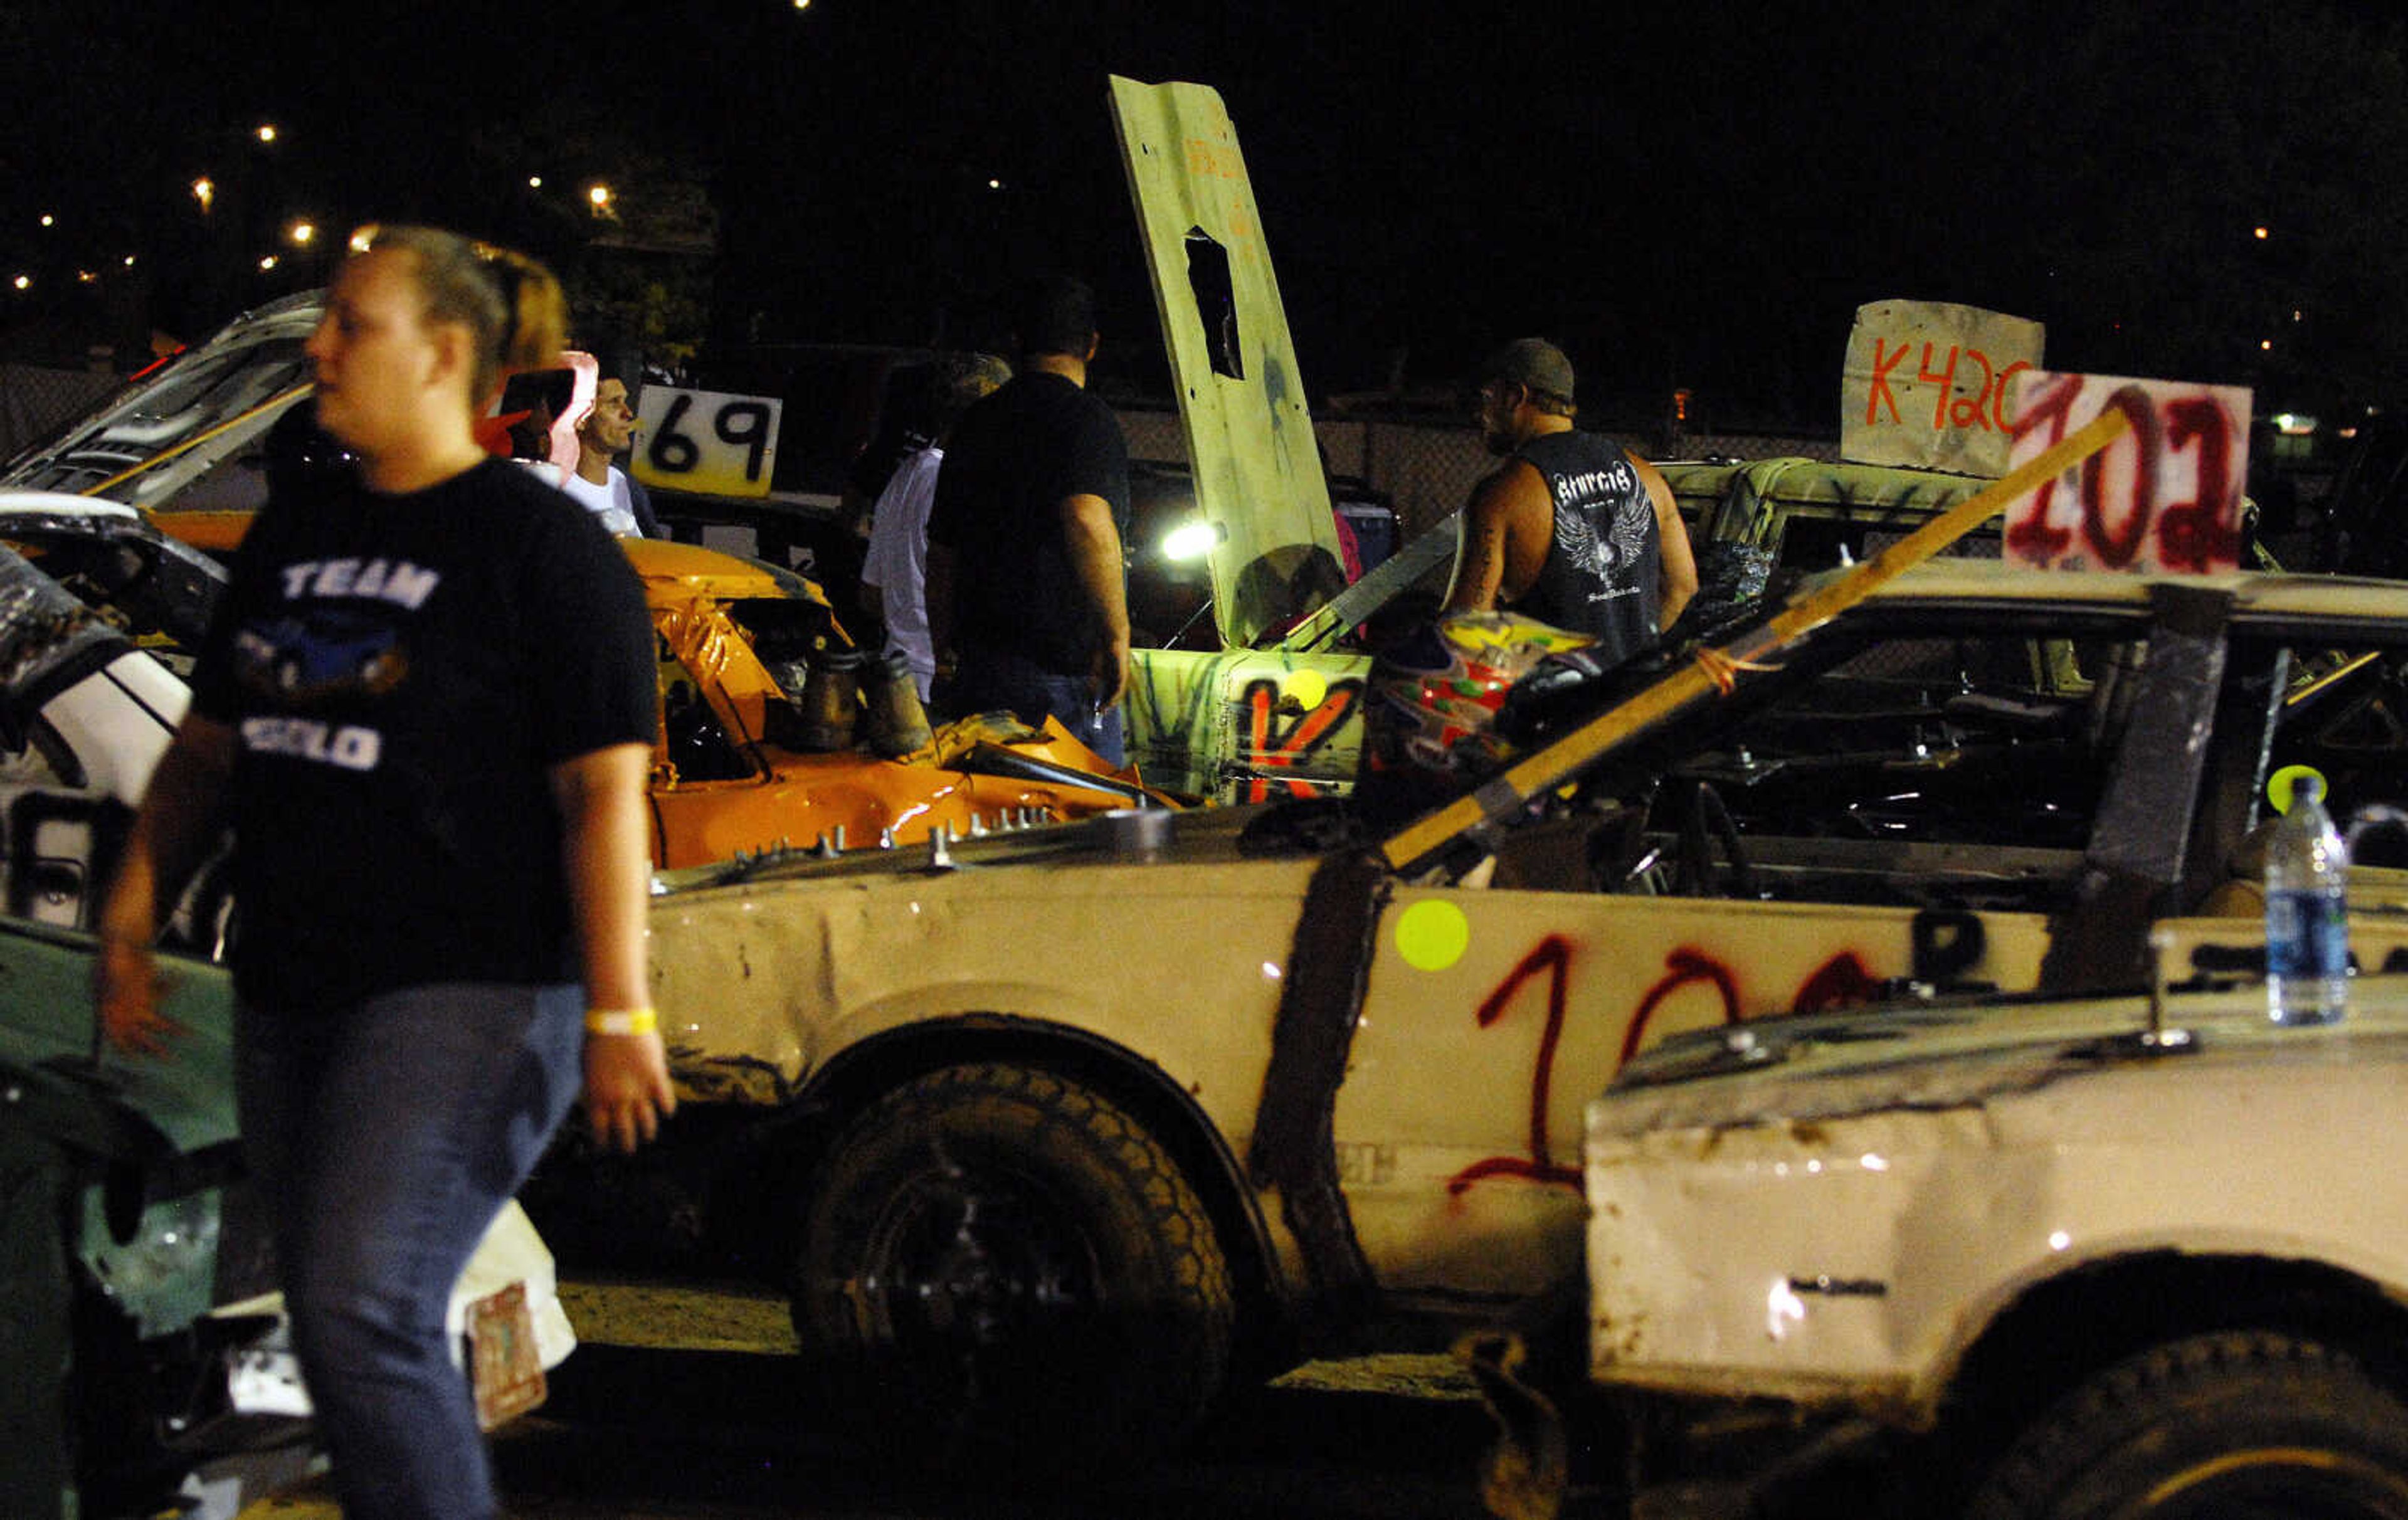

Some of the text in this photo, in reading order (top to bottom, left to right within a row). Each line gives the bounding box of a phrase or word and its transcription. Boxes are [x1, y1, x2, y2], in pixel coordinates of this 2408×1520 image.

[648, 394, 771, 482] 69
[2009, 372, 2244, 570] 102
[278, 556, 442, 610] TEAM
